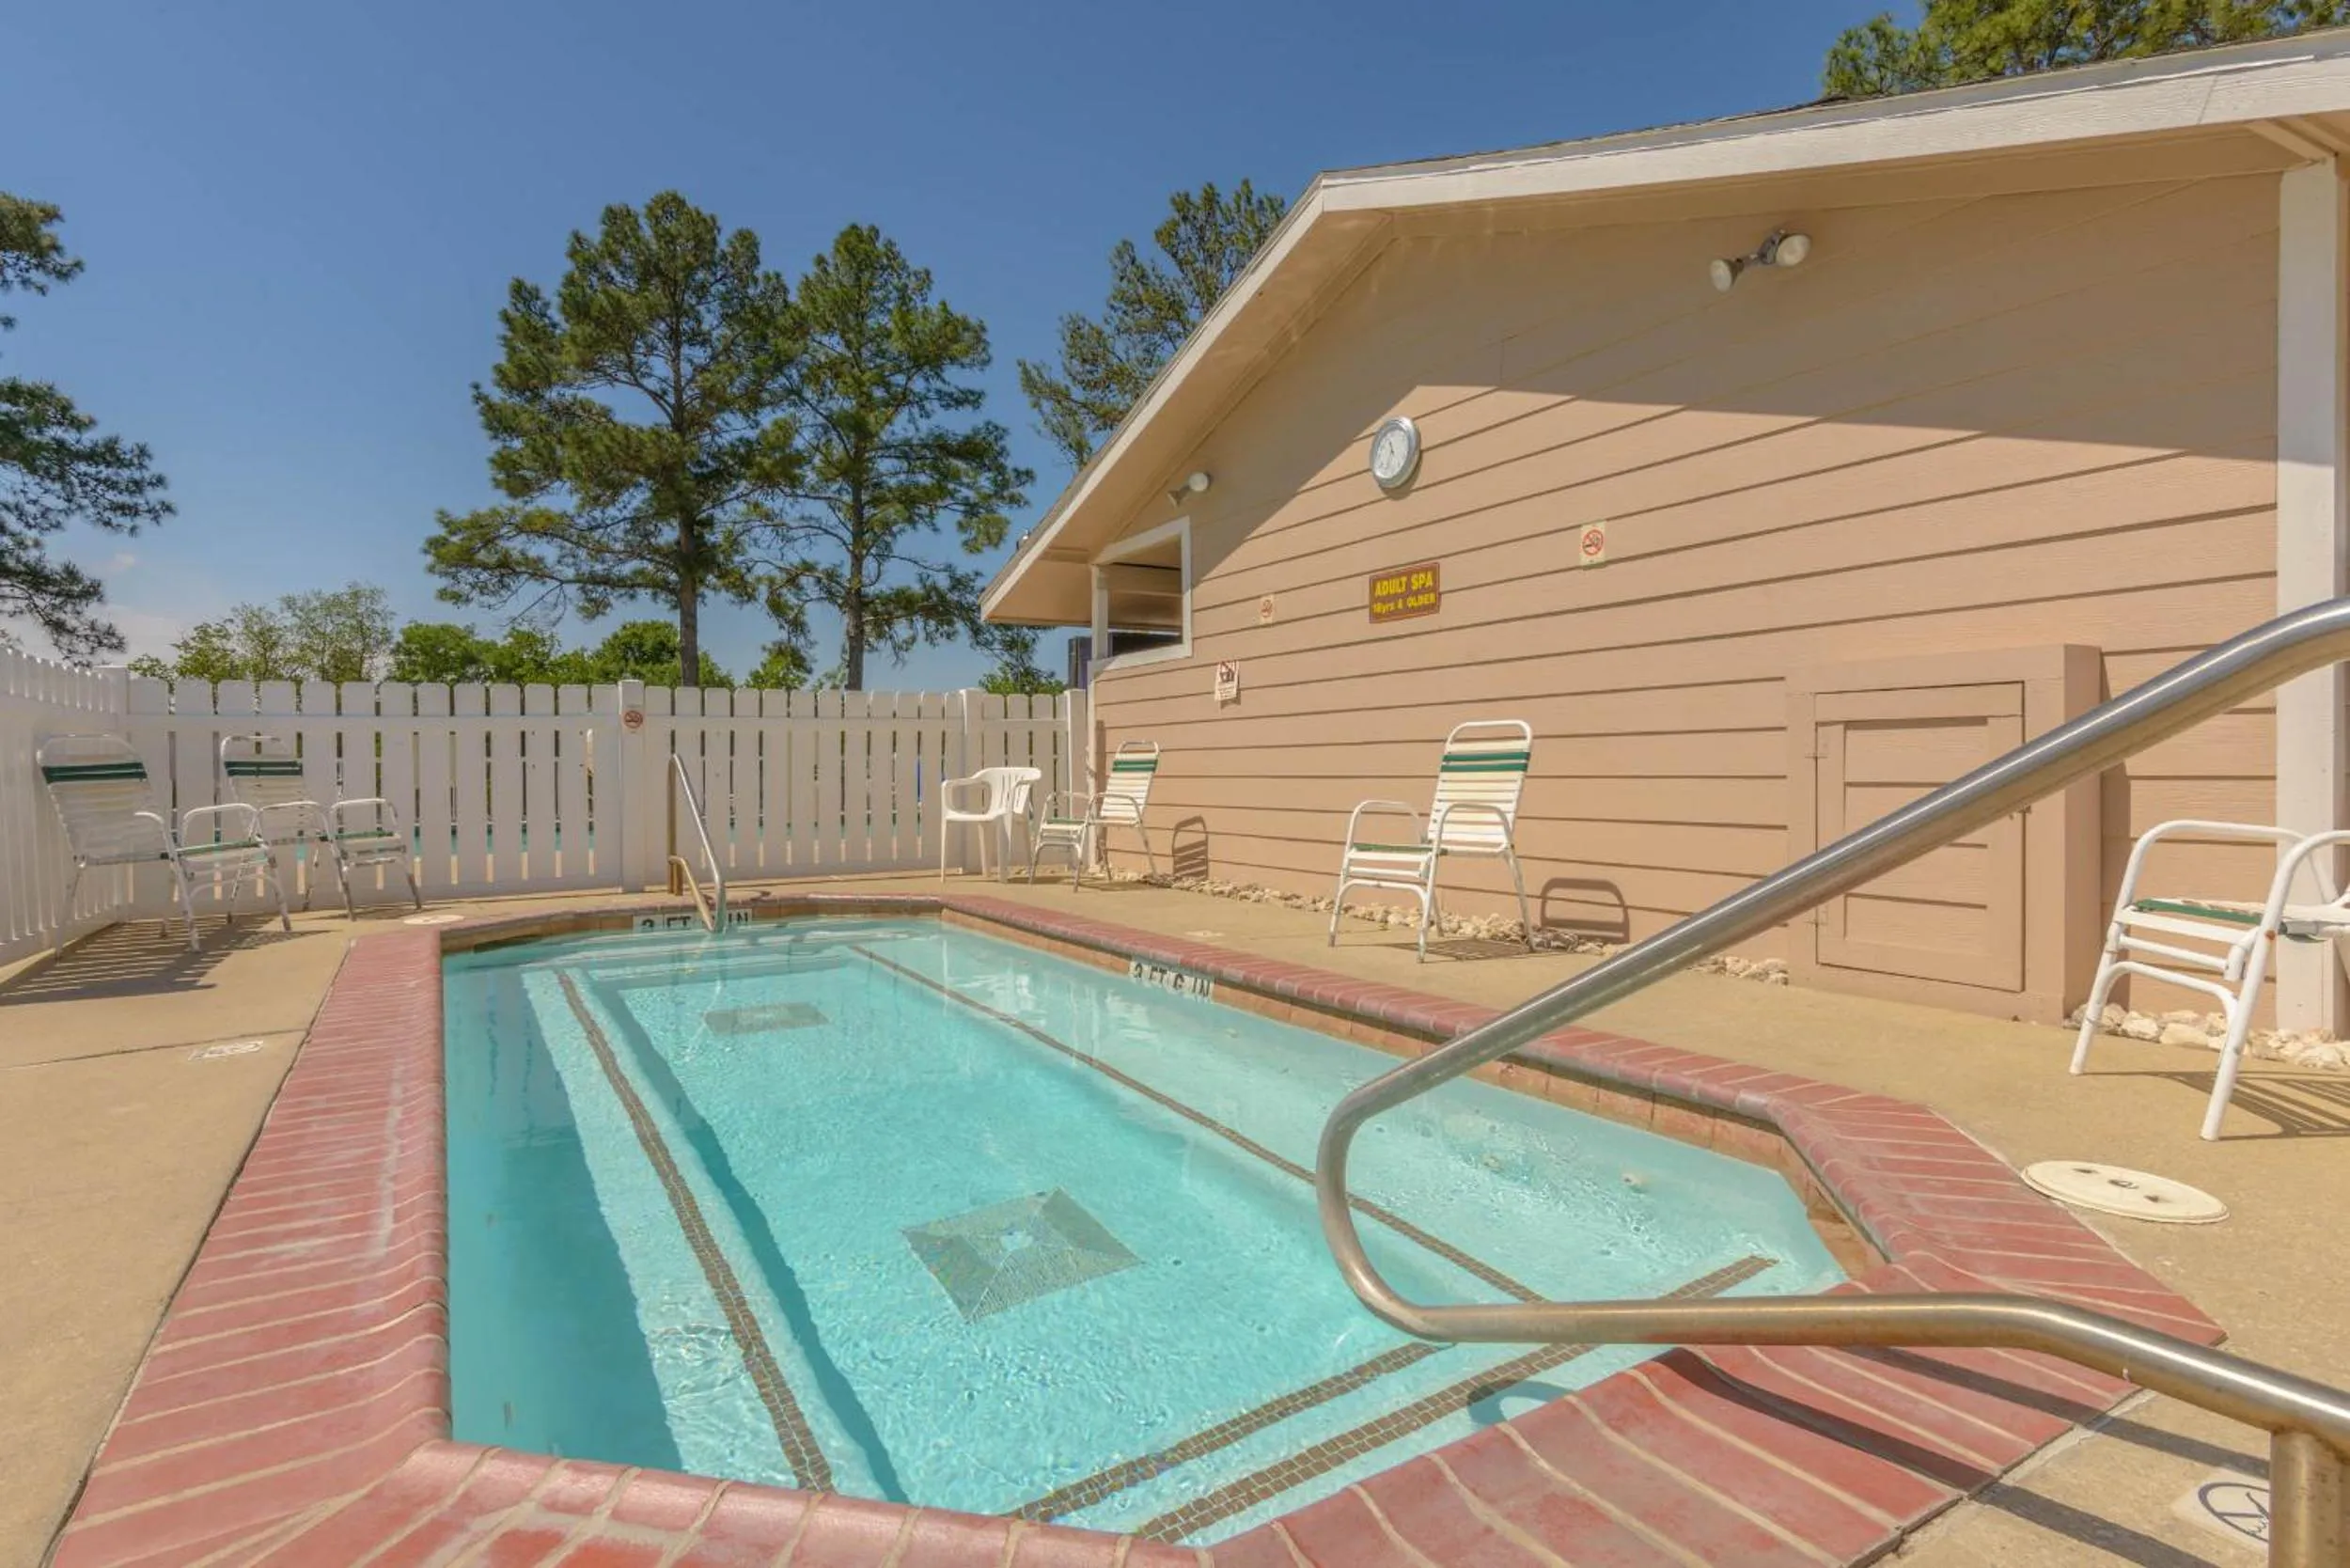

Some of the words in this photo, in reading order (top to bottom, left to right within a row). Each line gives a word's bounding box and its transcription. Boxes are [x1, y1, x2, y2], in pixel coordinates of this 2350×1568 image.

[1375, 575, 1407, 597] ADULT
[1411, 572, 1433, 590] SPA
[1407, 593, 1435, 608] OLDER
[728, 912, 748, 923] IN
[1149, 965, 1167, 983] FT
[1192, 977, 1211, 997] IN
